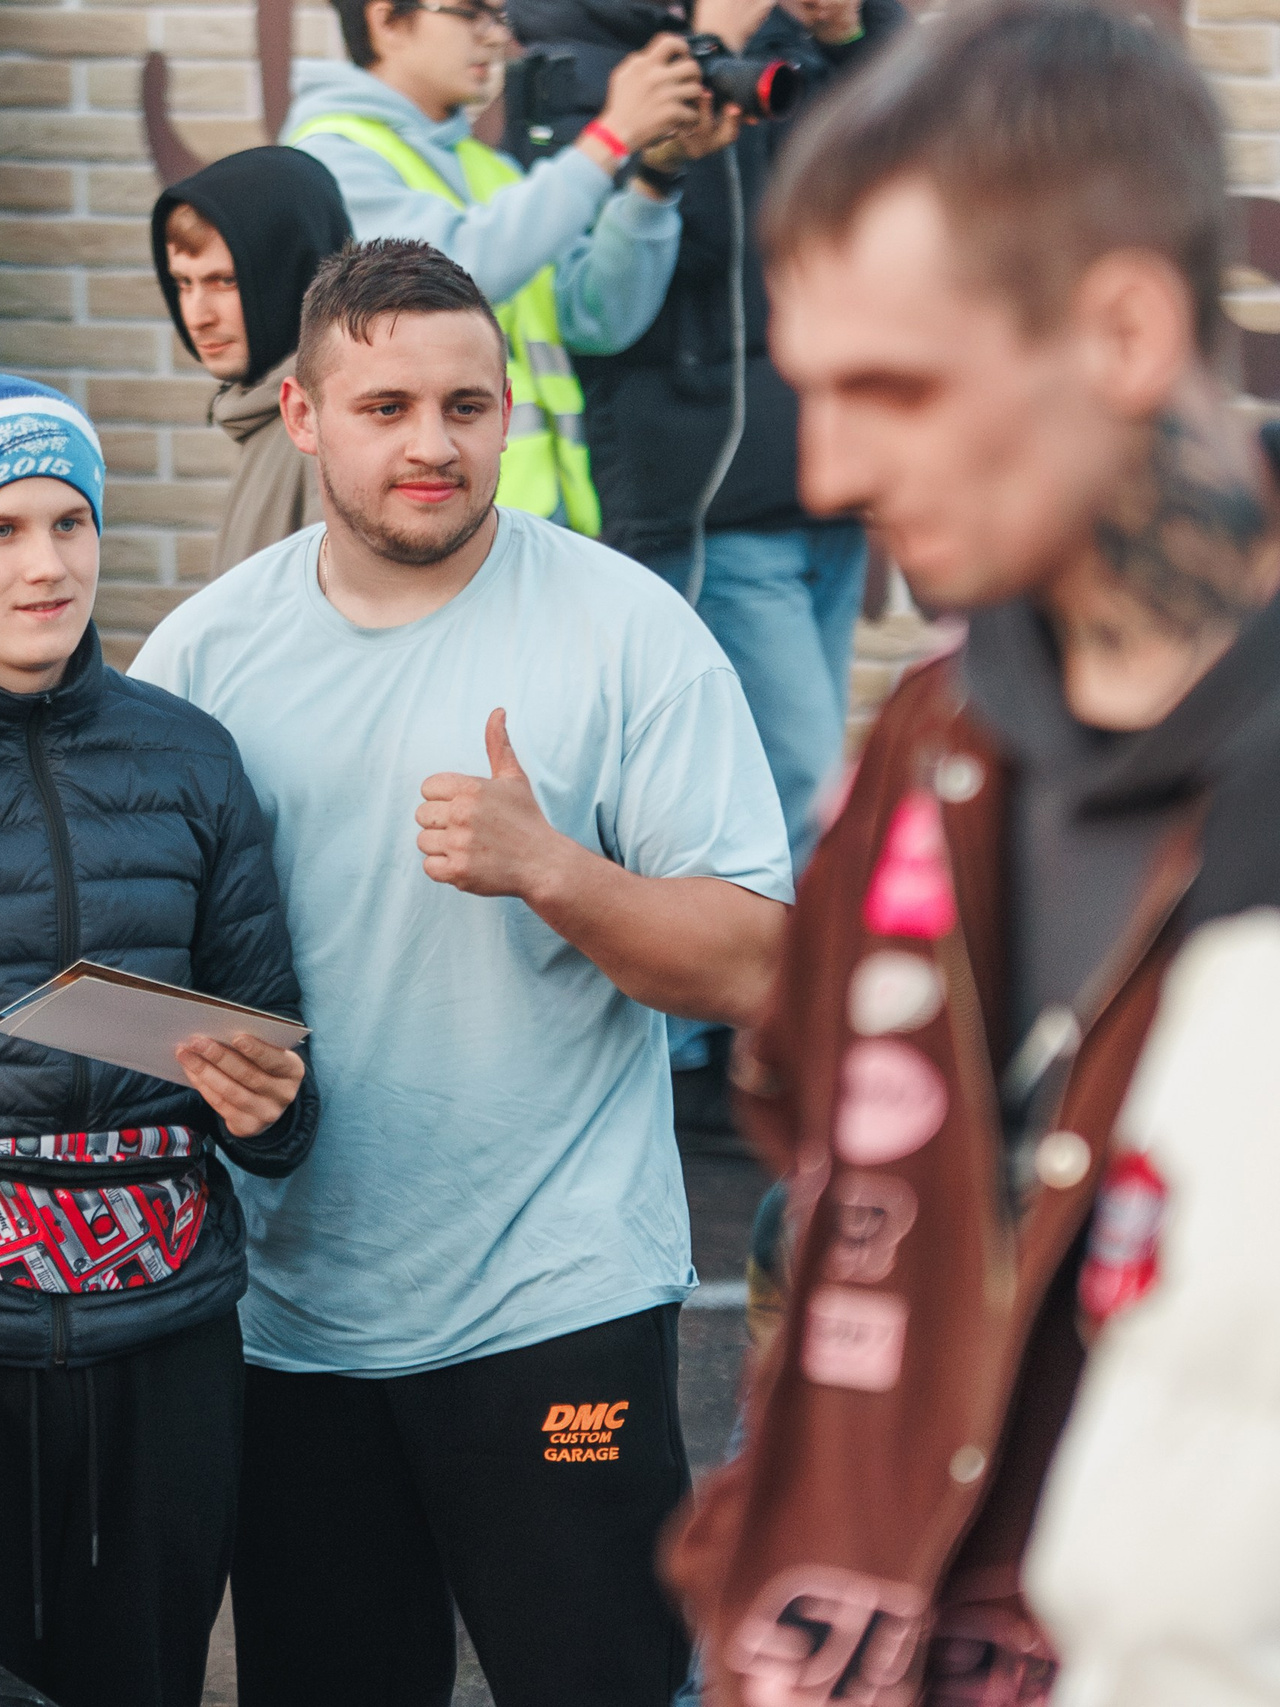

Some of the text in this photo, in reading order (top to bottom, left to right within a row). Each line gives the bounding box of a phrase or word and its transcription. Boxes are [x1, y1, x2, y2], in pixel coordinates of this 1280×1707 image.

[541, 1400, 629, 1432] DMC
[549, 1431, 612, 1444] CUSTOM
[544, 1447, 620, 1462] GARAGE
